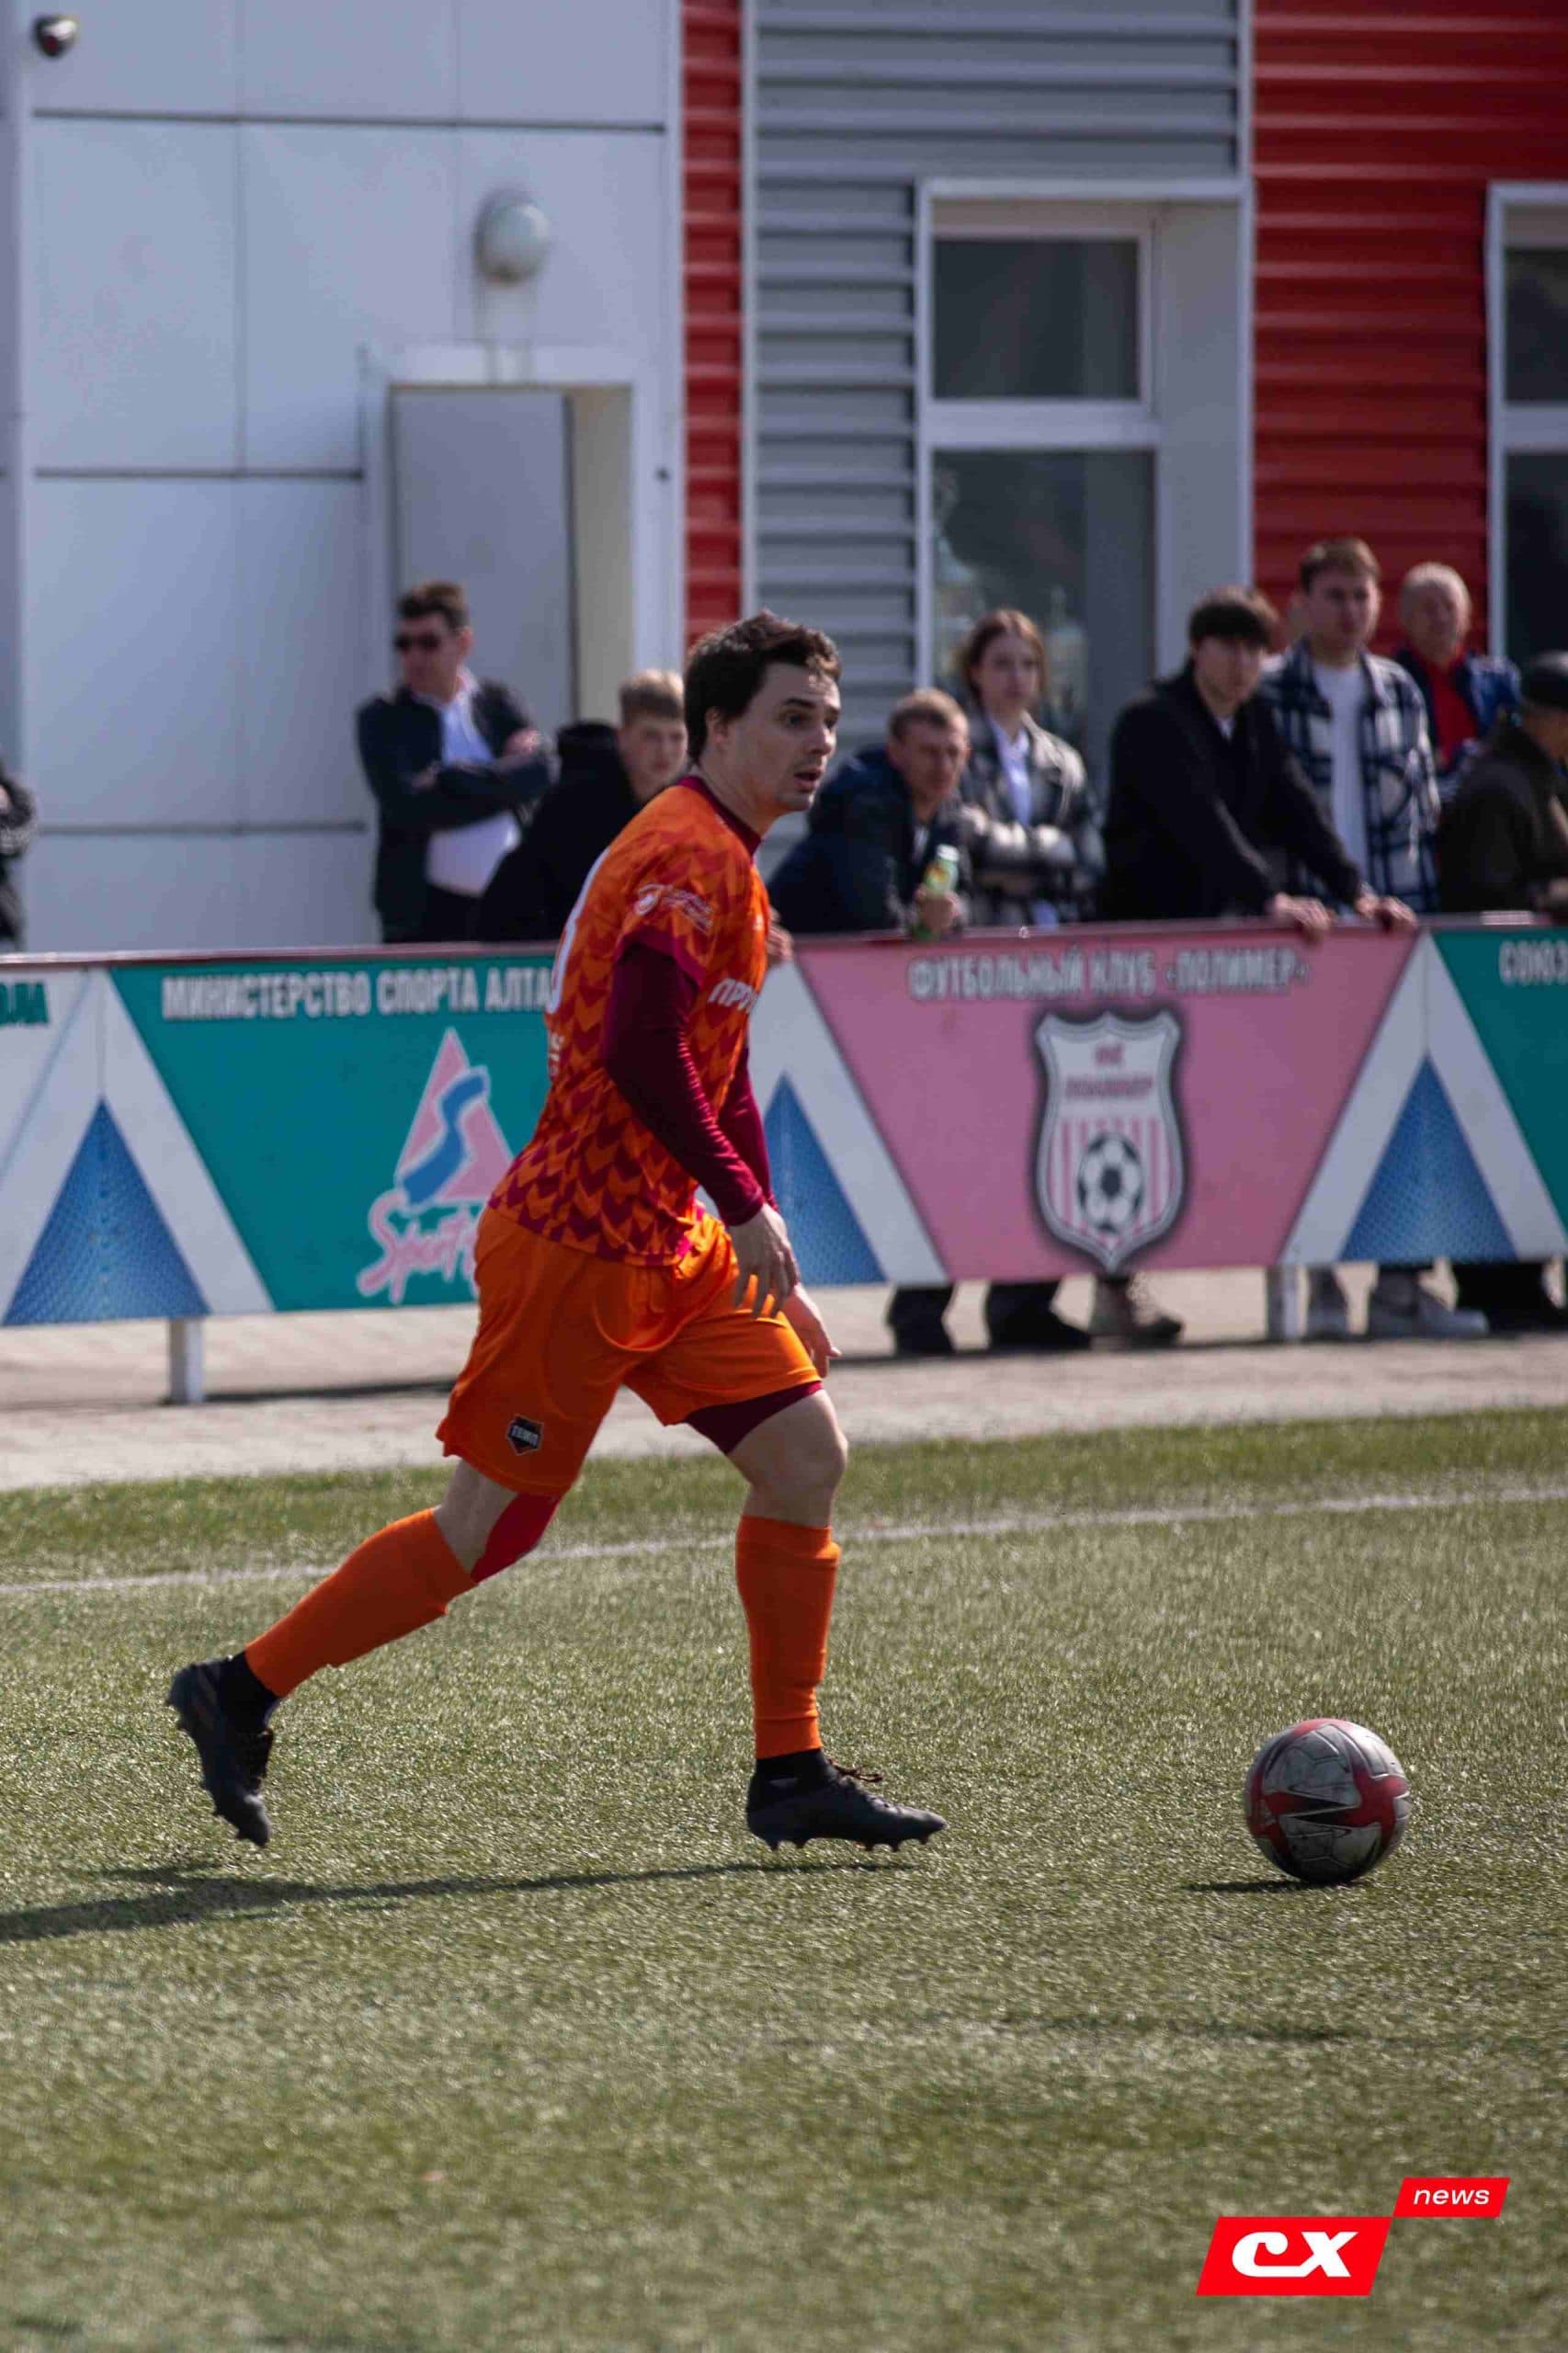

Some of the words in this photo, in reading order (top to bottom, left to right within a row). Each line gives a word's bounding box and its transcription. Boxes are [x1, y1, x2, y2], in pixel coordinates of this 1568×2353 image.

[161, 971, 372, 1020] МИНИСТЕРСТВО
[376, 967, 480, 1015] СПОРТА
[908, 946, 1084, 1000] ФУТБОЛЬНЫЙ
[1089, 949, 1155, 995] КЛУБ
